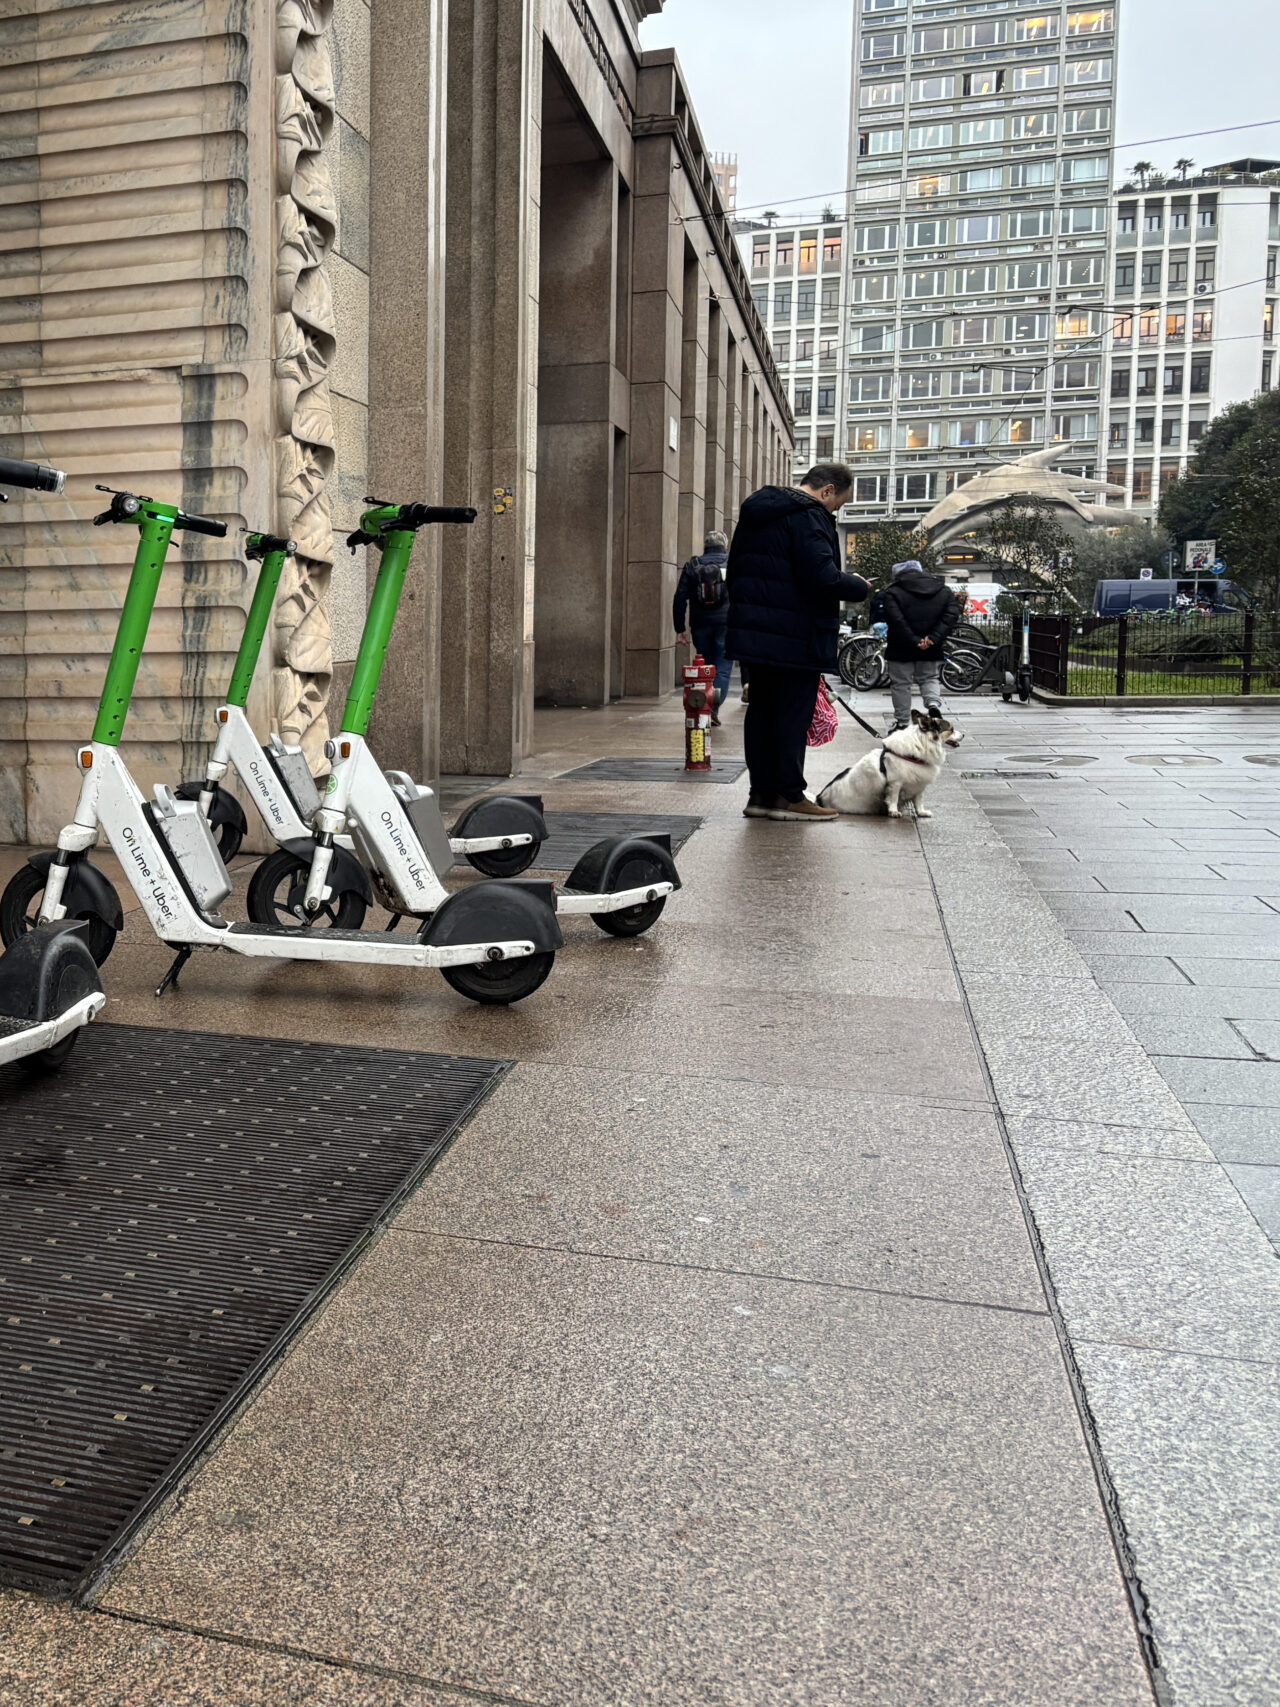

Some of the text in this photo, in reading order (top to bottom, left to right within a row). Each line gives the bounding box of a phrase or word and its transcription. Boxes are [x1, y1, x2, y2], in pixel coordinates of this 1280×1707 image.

[250, 761, 259, 776] On
[255, 775, 270, 797] Lime
[269, 803, 284, 825] Uber
[122, 827, 136, 848] On
[130, 846, 151, 877] Lime
[152, 886, 173, 920] Uber
[381, 811, 394, 830] On
[389, 828, 407, 856] Lime
[408, 863, 426, 891] Uber
